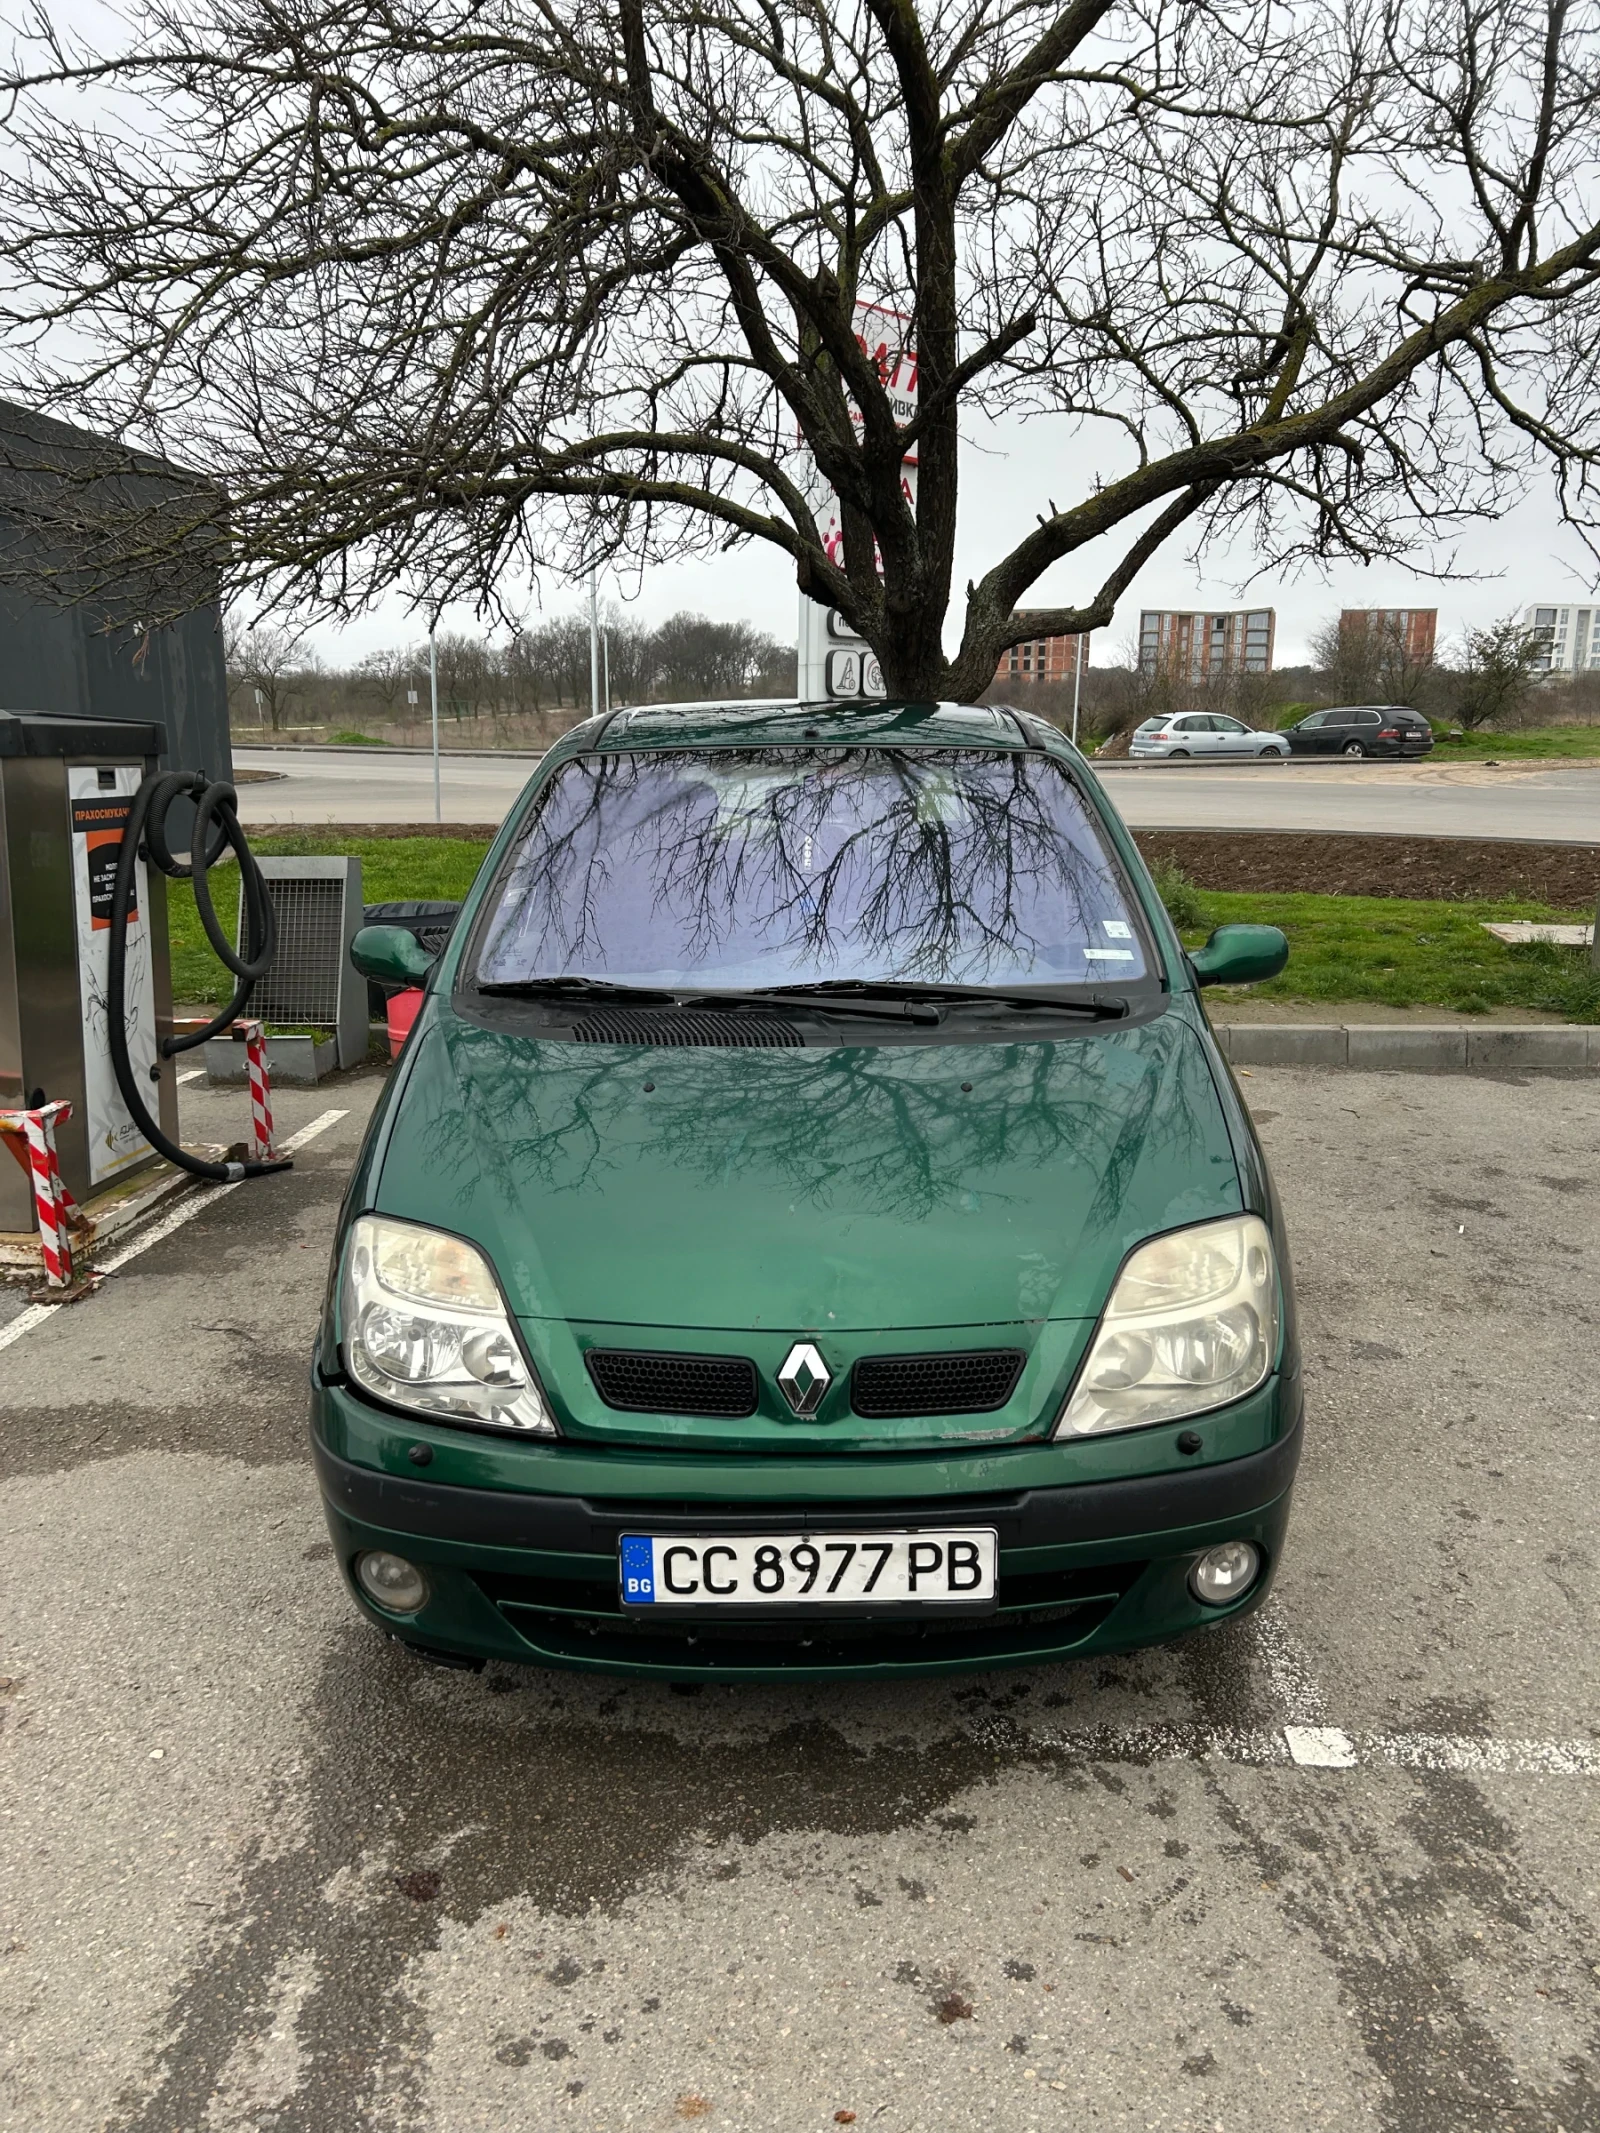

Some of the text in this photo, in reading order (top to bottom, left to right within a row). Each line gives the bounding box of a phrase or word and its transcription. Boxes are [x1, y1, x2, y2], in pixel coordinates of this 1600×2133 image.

[628, 1577, 652, 1593] BG
[663, 1540, 982, 1595] CC 8977 PB
